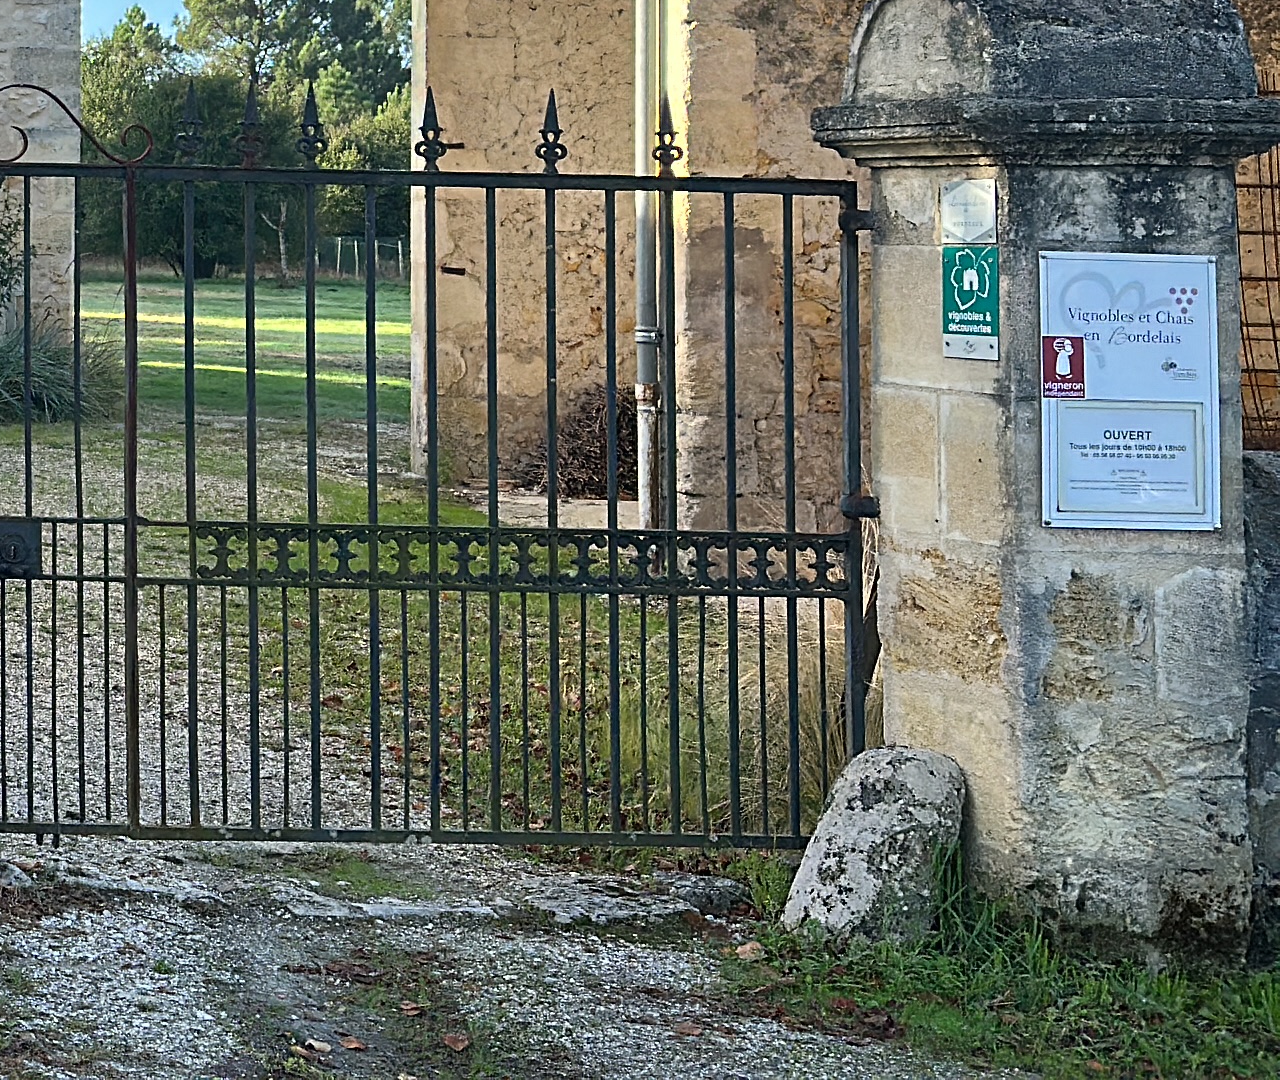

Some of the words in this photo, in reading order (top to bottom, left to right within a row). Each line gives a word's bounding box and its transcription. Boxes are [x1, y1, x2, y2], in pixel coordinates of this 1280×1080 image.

[947, 310, 984, 323] vignobles
[985, 311, 992, 322] &
[1068, 307, 1134, 324] Vignobles
[1139, 312, 1150, 323] et
[1155, 310, 1194, 325] Chais
[1083, 331, 1100, 341] en
[1108, 325, 1182, 346] Bordelais
[1044, 381, 1084, 392] vigneron
[1103, 429, 1152, 441] OUVERT
[1069, 442, 1087, 450] Tous
[1102, 443, 1121, 452] jours
[1123, 443, 1132, 451] de
